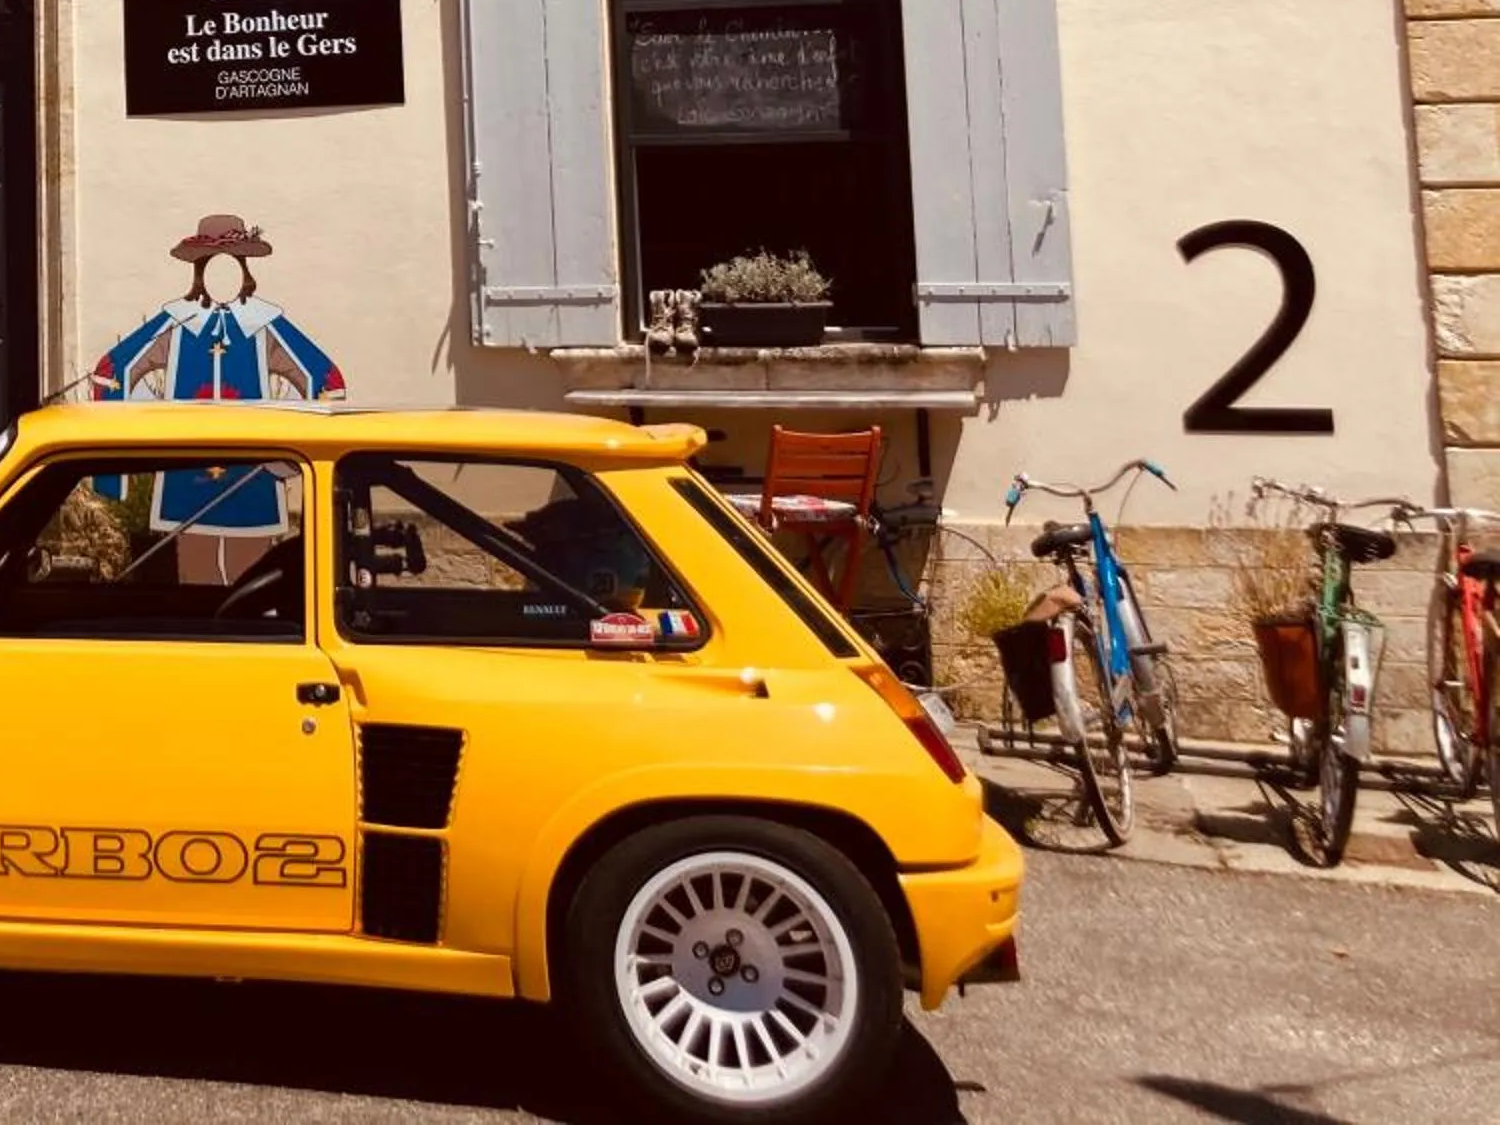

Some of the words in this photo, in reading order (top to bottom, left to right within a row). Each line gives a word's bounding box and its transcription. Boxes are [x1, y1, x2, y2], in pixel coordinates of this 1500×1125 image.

[185, 14, 216, 36] Le
[223, 9, 329, 34] Bonheur
[167, 43, 200, 64] est
[206, 38, 262, 61] dans
[269, 36, 290, 58] le
[297, 33, 357, 56] Gers
[217, 67, 301, 84] GASCOGNE
[214, 82, 309, 100] D'ARTAGNAN
[1175, 219, 1334, 436] 2
